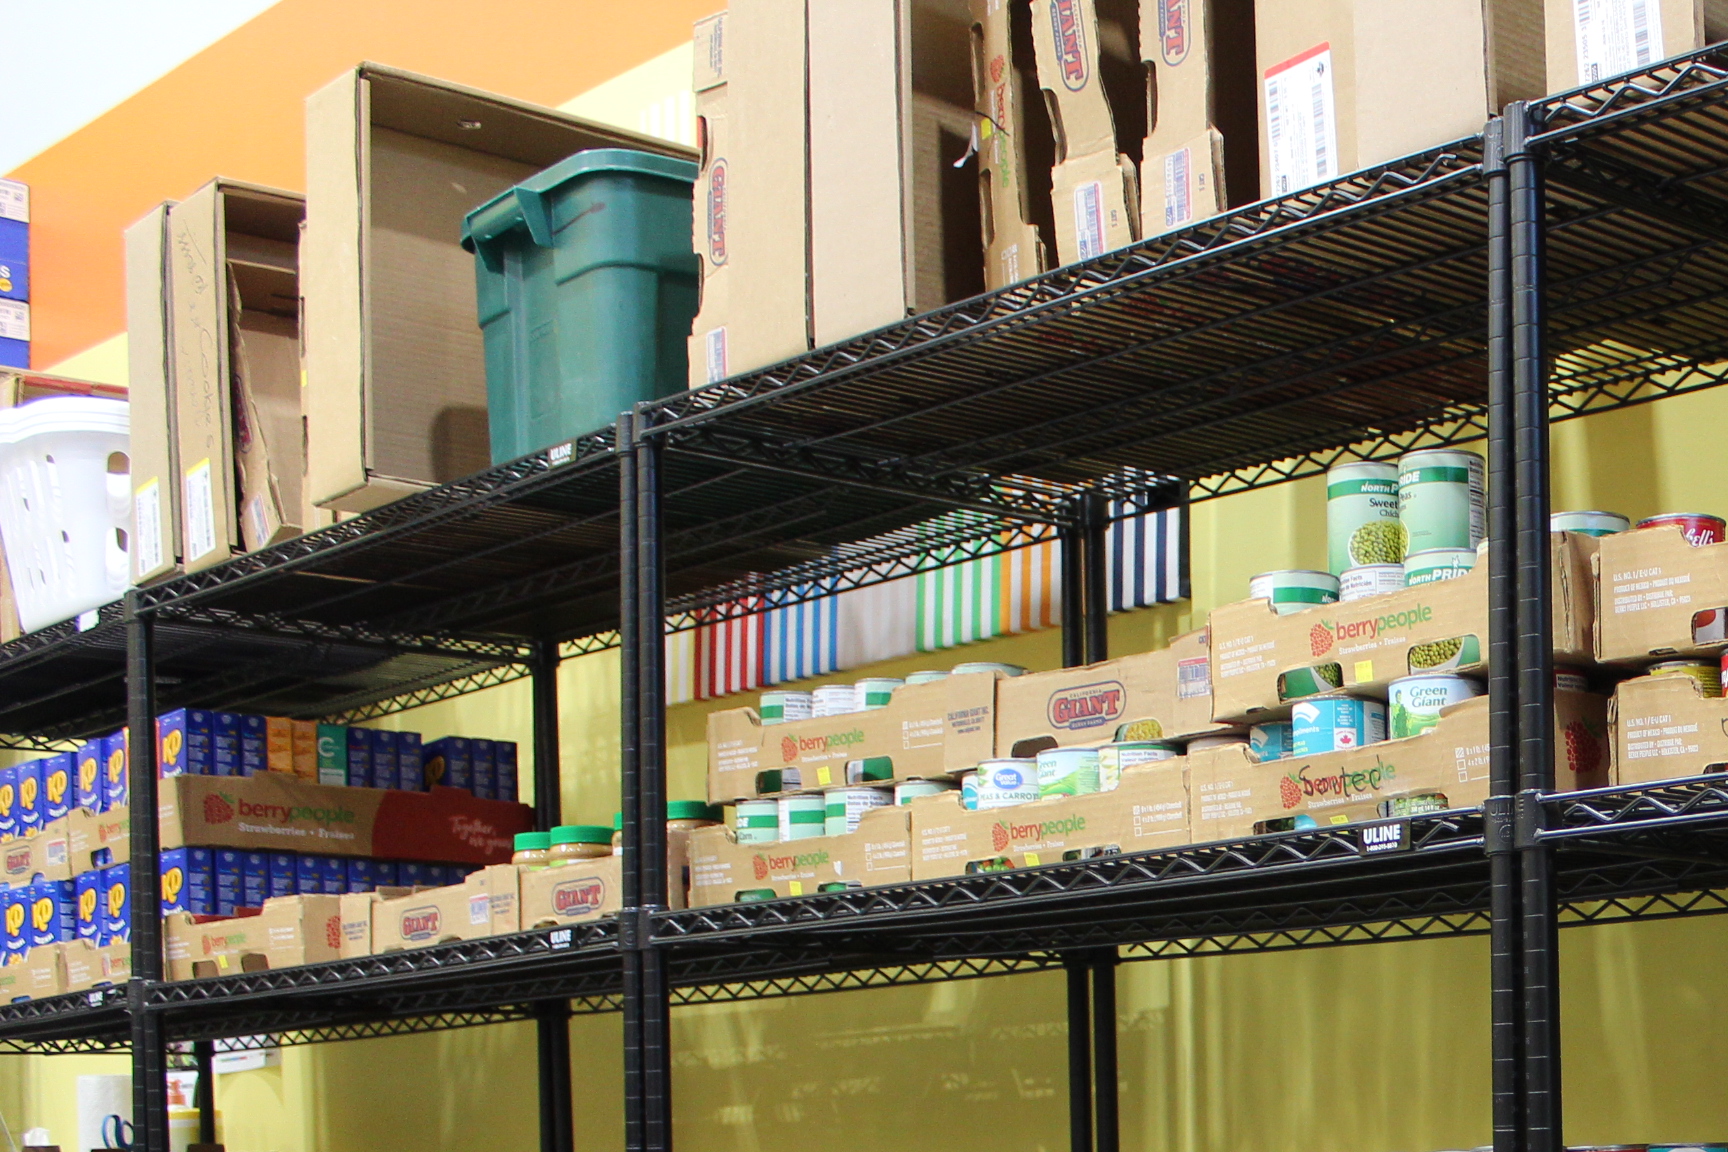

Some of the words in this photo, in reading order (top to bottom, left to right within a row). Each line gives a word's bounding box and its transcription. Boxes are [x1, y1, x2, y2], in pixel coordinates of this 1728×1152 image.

[1361, 480, 1389, 493] NORTH
[1369, 497, 1398, 509] Sweet
[1336, 602, 1432, 641] berrypeople
[1409, 686, 1448, 697] Green
[1411, 695, 1446, 708] Giant
[1053, 689, 1121, 722] GIANT
[799, 728, 865, 752] berrypeople
[995, 771, 1018, 783] Great
[238, 800, 354, 825] berrypeople
[1011, 813, 1086, 841] berrypeople
[1363, 823, 1402, 845] ULINE
[770, 849, 829, 870] berrypeople
